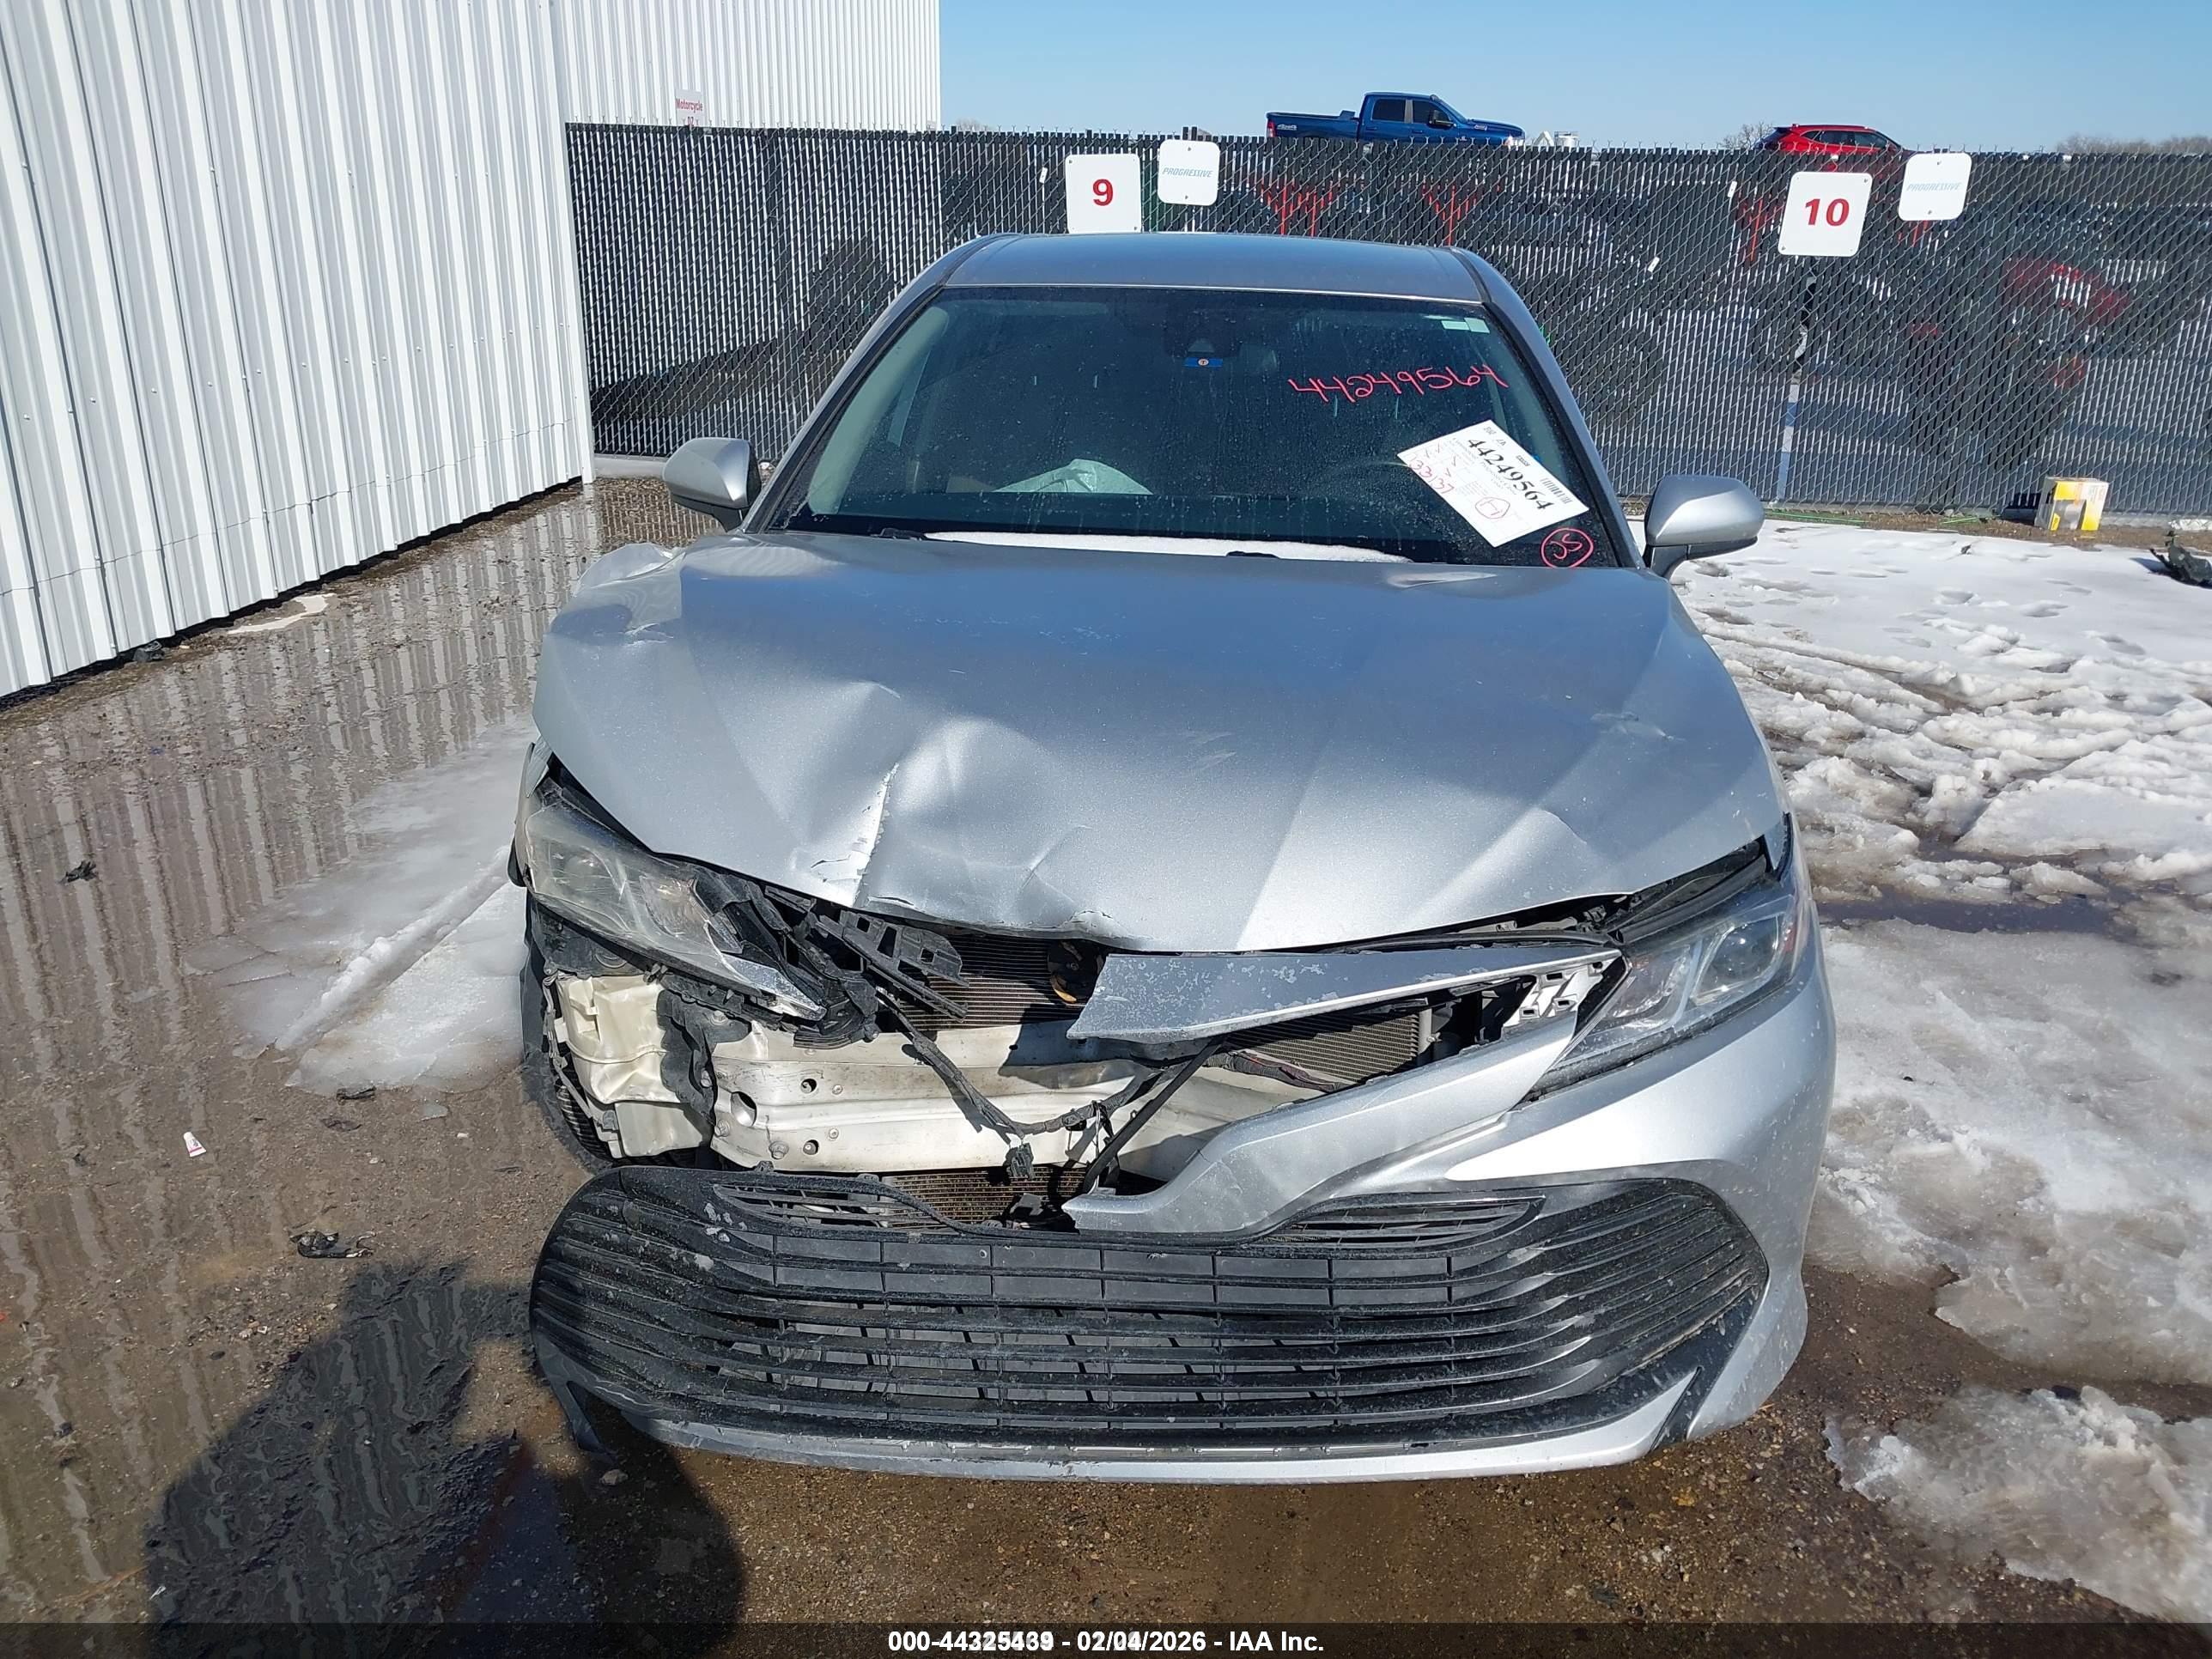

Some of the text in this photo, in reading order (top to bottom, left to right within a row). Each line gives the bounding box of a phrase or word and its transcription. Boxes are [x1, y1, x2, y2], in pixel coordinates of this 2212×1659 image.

[675, 98, 703, 113] Motorcycle
[1162, 167, 1213, 178] PROGRESSIVE
[1092, 179, 1114, 206] 9
[1906, 182, 1961, 192] PROGRESSIVE
[1804, 198, 1850, 227] 10
[1287, 363, 1510, 404] 44249564
[1468, 439, 1555, 510] 44249564
